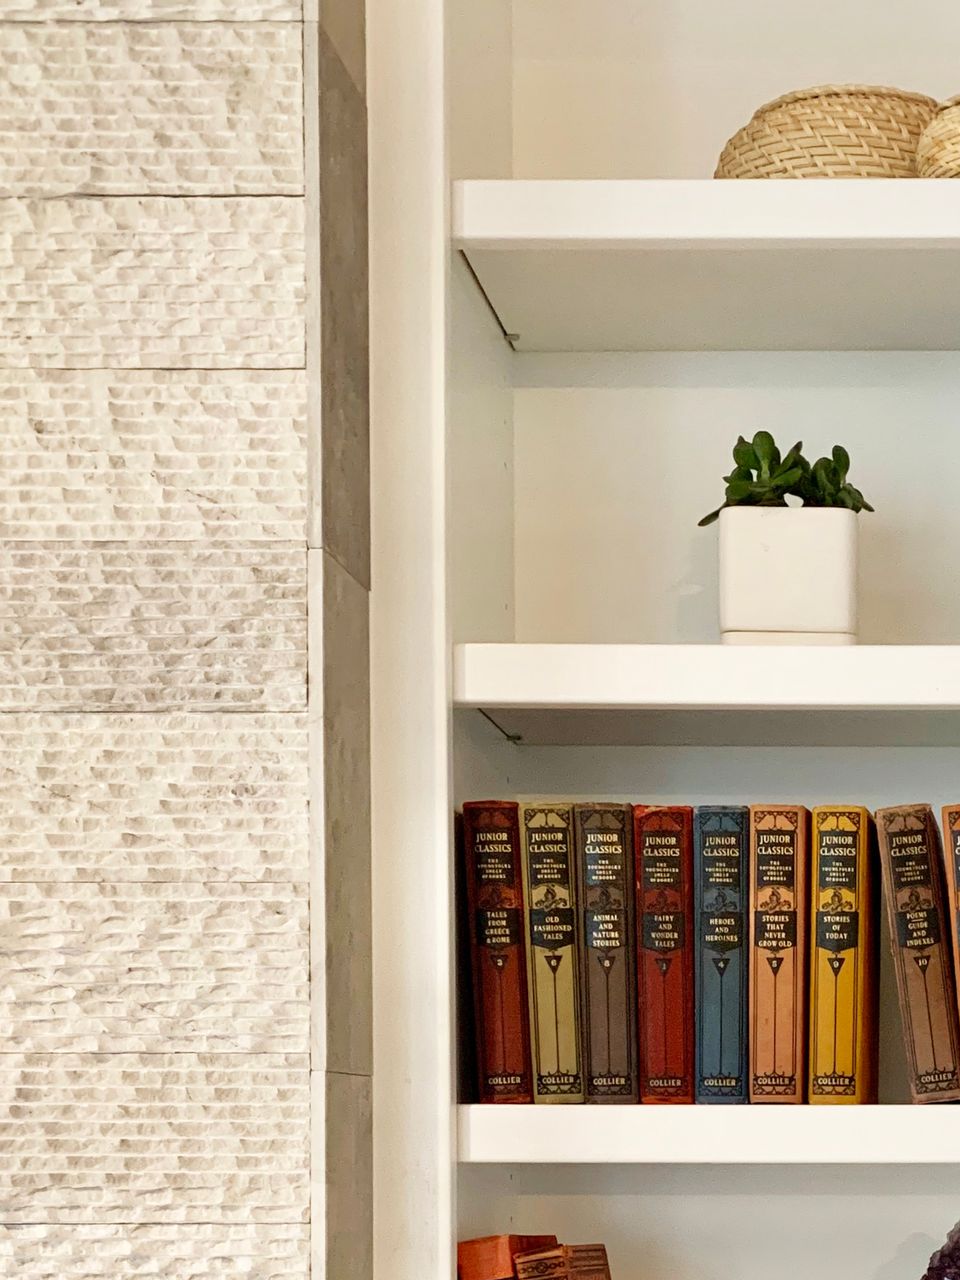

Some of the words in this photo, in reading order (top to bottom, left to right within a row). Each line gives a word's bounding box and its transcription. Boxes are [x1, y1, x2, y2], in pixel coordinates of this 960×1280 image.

[476, 832, 508, 842] JUNIOR
[532, 833, 563, 843] JUNIOR
[586, 834, 618, 844] JUNIOR
[646, 837, 677, 846] JUNIOR
[706, 837, 736, 846] JUNIOR
[759, 835, 791, 845] JUNIOR
[822, 836, 853, 846] JUNIOR
[893, 835, 922, 847] JUNIOR
[475, 844, 512, 853] CLASSICS
[529, 844, 567, 853] CLASSICS
[585, 846, 622, 854] CLASSICS
[643, 848, 680, 856] CLASSICS
[703, 848, 739, 856] CLASSICS
[757, 847, 794, 855] CLASSICS
[820, 848, 856, 856] CLASSICS
[891, 846, 927, 856] CLASSICS
[907, 911, 927, 920] POEMS
[534, 924, 572, 932] FASHIONED
[908, 921, 928, 929] GUIDE
[907, 938, 934, 946] INDEXES
[833, 960, 839, 968] 9
[488, 1076, 521, 1085] COLLIER
[542, 1076, 574, 1084] COLLIER
[593, 1078, 626, 1086] COLLIER
[704, 1078, 736, 1086] COLLIER
[758, 1078, 790, 1086] COLLIER
[818, 1077, 850, 1086] COLLIER
[920, 1073, 953, 1082] COLLIER
[650, 1079, 682, 1087] COLLIER
